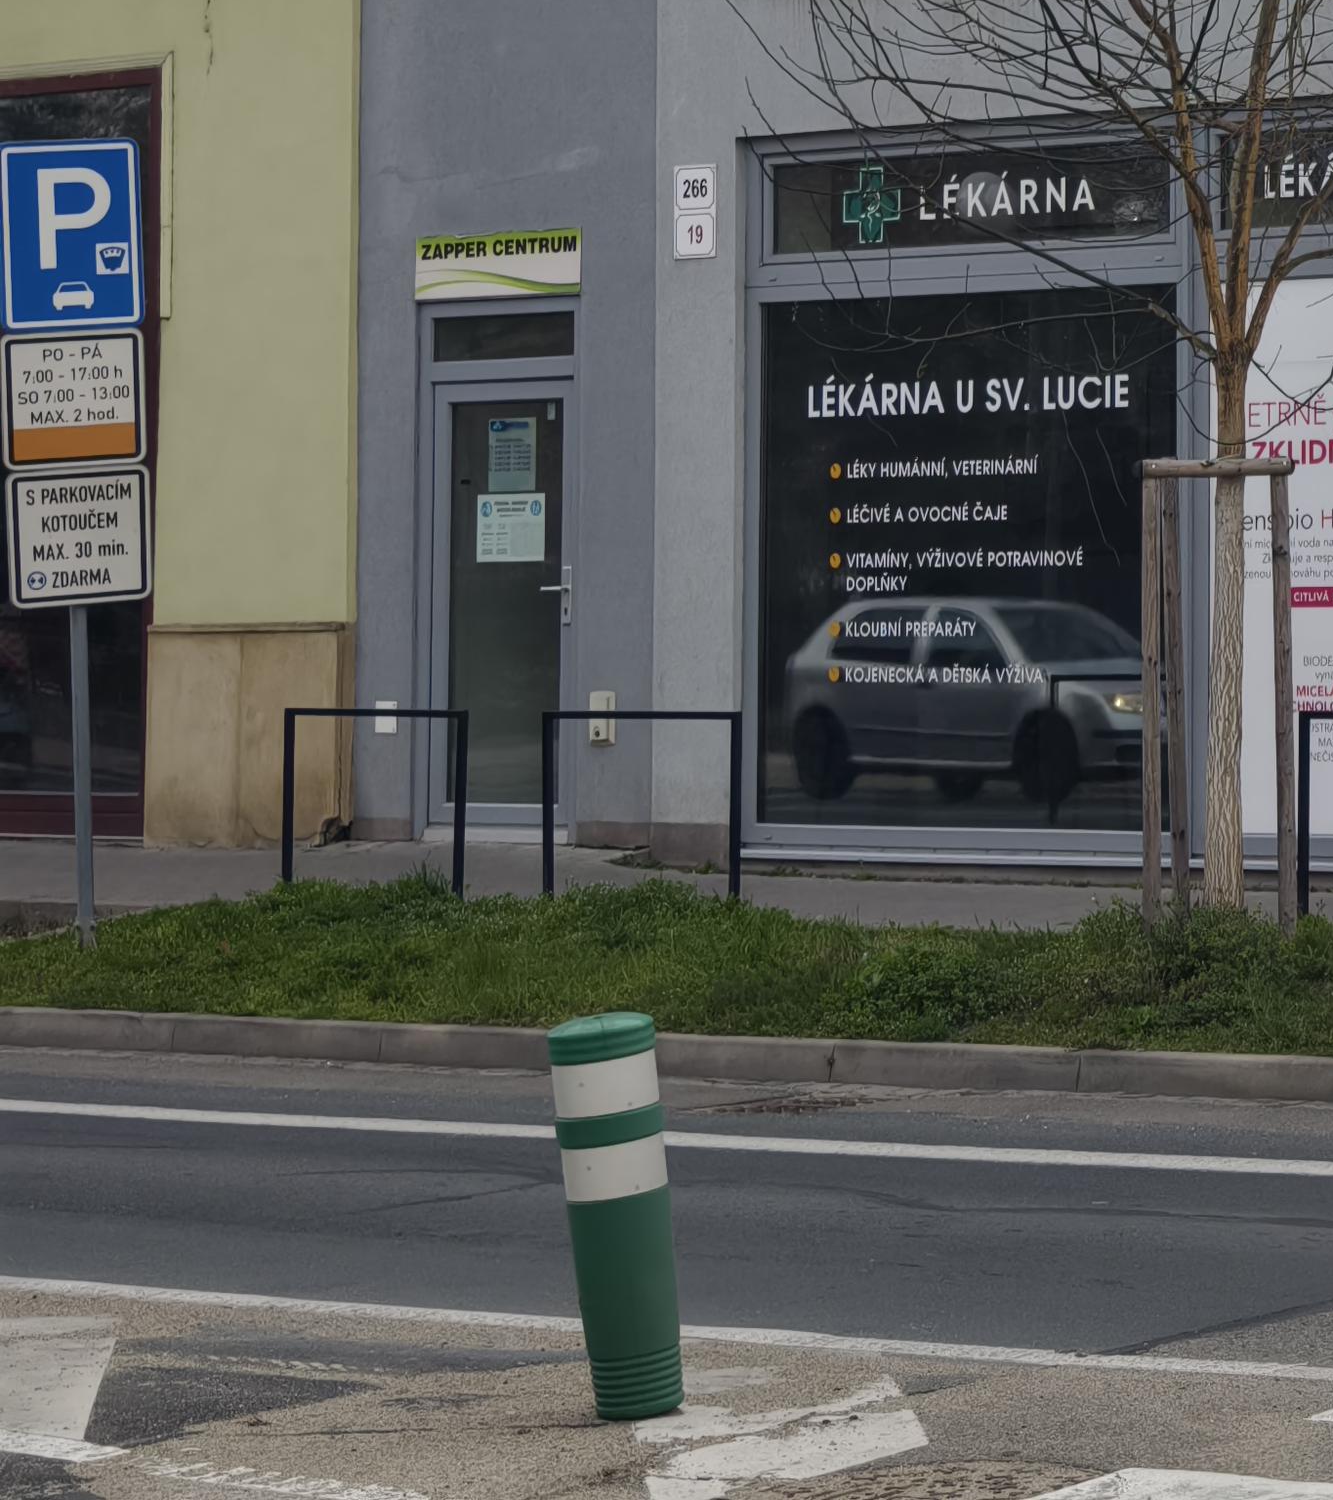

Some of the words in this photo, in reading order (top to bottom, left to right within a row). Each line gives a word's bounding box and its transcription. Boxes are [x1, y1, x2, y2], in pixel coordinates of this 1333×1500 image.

[683, 178, 708, 199] 266
[919, 170, 1096, 221] LÉKÁRNA
[37, 167, 111, 270] P
[688, 224, 703, 244] 19
[421, 241, 487, 260] ZAPPER
[492, 236, 577, 256] CENTRUM
[42, 348, 64, 362] PO
[81, 343, 103, 360] PÁ
[71, 366, 109, 381] 17:00
[114, 365, 123, 378] h
[18, 390, 39, 405] SO
[91, 385, 130, 400] 13:00
[807, 373, 945, 418] LÉKÁRNA
[956, 379, 974, 413] U
[985, 377, 1030, 412] SV.
[1043, 373, 1129, 410] LUCIE
[30, 409, 69, 425] MAX.
[73, 408, 82, 422] 2
[87, 406, 119, 421] hod.
[1248, 393, 1327, 428] ETRNĚ
[847, 458, 876, 479] LÉKY
[880, 456, 948, 479] HUMÁNNÍ,
[952, 454, 1039, 477] VETERINÁRNÍ
[26, 489, 35, 506] S
[41, 479, 132, 505] PARKOVACÍM
[41, 509, 119, 533] KOTOUČEM
[846, 504, 891, 524] LÉČIVÉ
[894, 506, 904, 522] A
[908, 501, 969, 523] OVOCNÉ
[973, 502, 1008, 522] ČAJE
[1242, 507, 1314, 532] ensio
[33, 543, 69, 562] MAX.
[75, 541, 92, 559] 30
[98, 539, 129, 557] min.
[1298, 537, 1320, 548] voda
[846, 550, 913, 570] VITAMÍNY,
[916, 548, 984, 569] VÝŽIVOVÉ
[987, 546, 1084, 568] POTRAVINOVÉ
[52, 568, 112, 588] ZDARMA
[846, 573, 908, 592] DOPLŇKY
[1293, 590, 1329, 602] CITLIVÁ
[845, 618, 901, 637] KLOUBNÍ
[905, 617, 977, 637] PREPARÁTY
[845, 663, 924, 683] KOJENECKÁ
[928, 665, 939, 682] A
[943, 664, 992, 683] DĚTSKÁ
[996, 664, 1044, 683] VÝŽIVA
